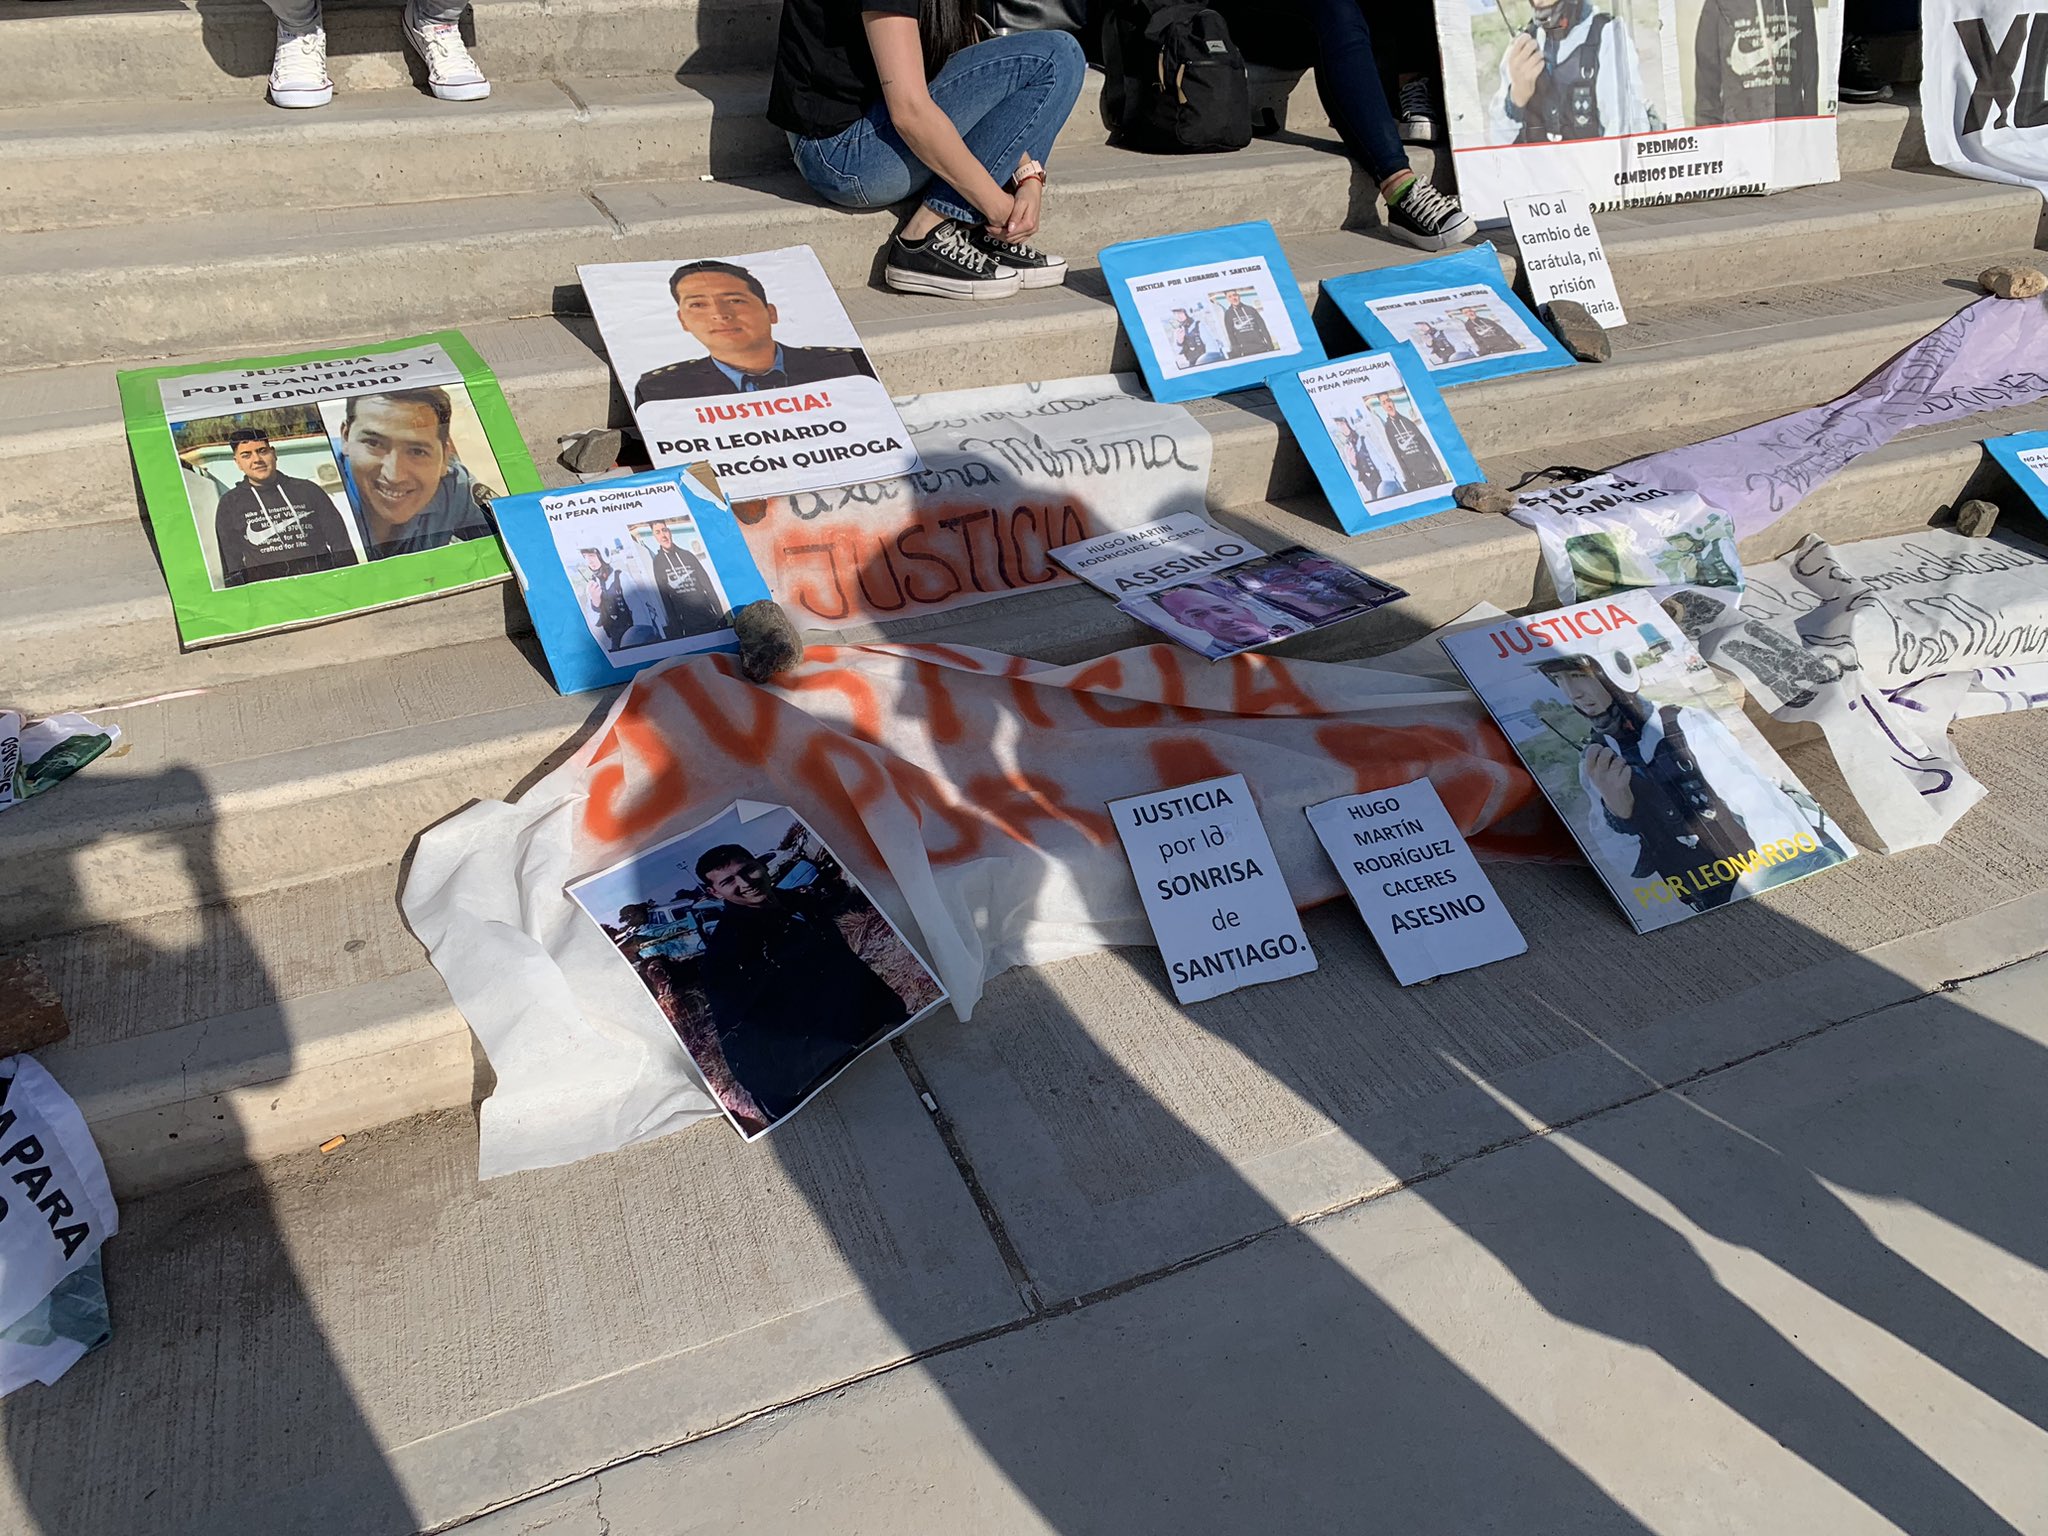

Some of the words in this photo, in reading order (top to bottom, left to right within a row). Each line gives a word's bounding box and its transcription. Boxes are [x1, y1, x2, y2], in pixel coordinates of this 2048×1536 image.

[1637, 136, 1699, 156] PEDIMOS:
[1614, 166, 1667, 186] CAMBIOS
[1669, 164, 1684, 179] DE
[1687, 160, 1723, 177] LEYES
[1528, 202, 1551, 217] NO
[1554, 199, 1567, 214] al
[1522, 226, 1571, 245] cambio
[1573, 223, 1591, 237] de
[1527, 251, 1586, 271] carátula,
[1588, 247, 1602, 262] ni
[1136, 282, 1165, 292] JUSTICIA
[1168, 278, 1182, 287] POR
[1184, 272, 1220, 284] LEONARDO
[1230, 265, 1261, 275] SANTIAGO
[1549, 276, 1596, 299] prisión
[182, 383, 250, 398] POR
[262, 362, 409, 387] SANTIAGO
[418, 357, 435, 365] Y
[241, 357, 372, 377] JUSTICIA
[1303, 377, 1315, 385] NO
[1339, 360, 1390, 377] DOMICILIARIA
[234, 375, 401, 404] LEONARDO
[1318, 382, 1341, 393] PENA
[695, 391, 833, 425] ¡JUSTICIA!
[656, 437, 712, 455] POR
[715, 420, 847, 451] LEONARDO
[711, 455, 787, 478] ARCÓN
[792, 437, 903, 467] QUIROGA
[545, 502, 563, 511] NO
[567, 499, 576, 507] A
[580, 496, 596, 505] LA
[600, 485, 676, 502] DOMICILIARIA
[549, 514, 562, 522] NI
[566, 507, 598, 519] PENA
[602, 500, 643, 513] MÍNIMA
[1085, 538, 1126, 554] HUGO
[1127, 524, 1173, 543] MARTIN
[1077, 543, 1149, 568] RODRIGUEZ
[1114, 543, 1245, 592] ASESINO
[1489, 604, 1638, 659] JUSTICIA
[1131, 788, 1233, 827] JUSTICIA
[1348, 797, 1400, 821] HUGO
[1353, 818, 1424, 847] MARTÍN
[1158, 835, 1198, 863] por
[1353, 839, 1455, 876] RODRÍGUEZ
[1157, 858, 1264, 901] SONRISA
[1382, 869, 1457, 898] CACERES
[1633, 875, 1691, 909] POR
[1687, 831, 1817, 891] LEONARDO
[1211, 908, 1241, 932] de
[1391, 893, 1486, 934] ASESINO
[1172, 934, 1307, 985] SANTIAGO.
[0, 1134, 91, 1261] PARA
